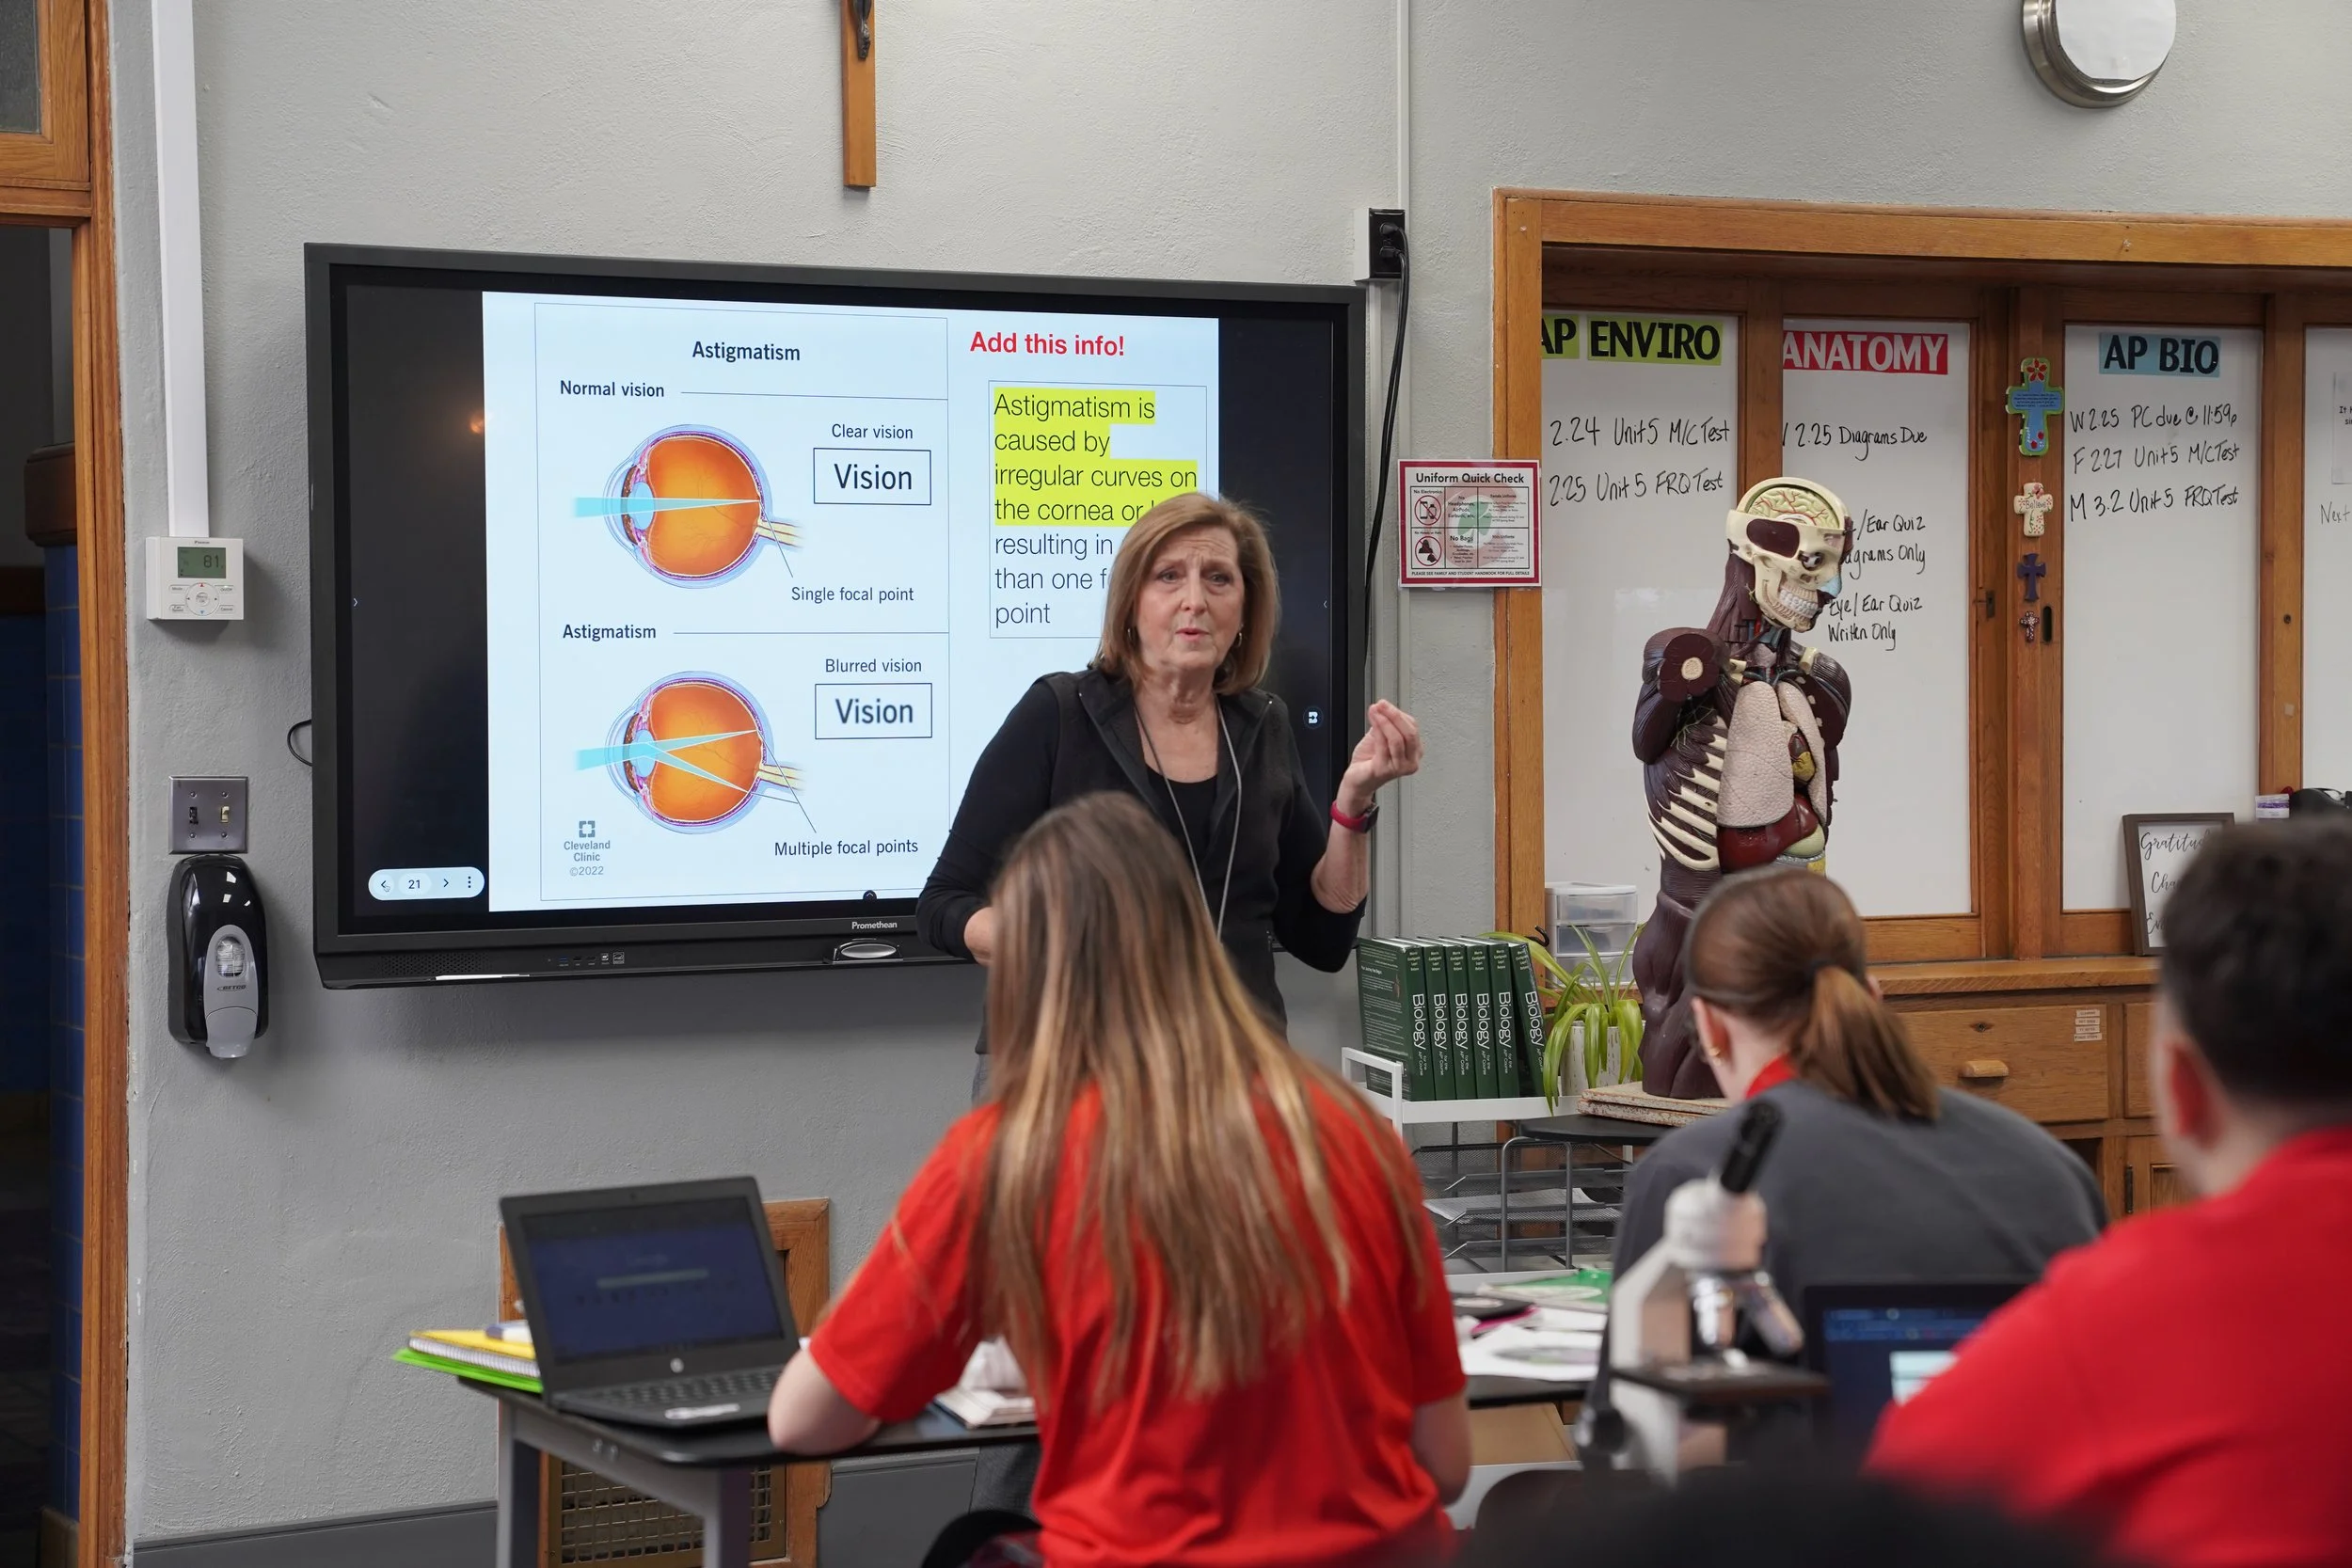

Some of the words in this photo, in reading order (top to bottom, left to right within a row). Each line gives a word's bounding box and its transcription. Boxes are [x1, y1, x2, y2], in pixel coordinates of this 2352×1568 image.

[691, 341, 802, 363] Astigmatism
[969, 330, 1018, 354] Add
[1025, 332, 1068, 355] this
[1073, 334, 1125, 356] info!
[1590, 319, 1721, 361] ENVIRO
[1783, 331, 1946, 372] ANATOMY
[2104, 334, 2148, 371] AP
[2159, 337, 2219, 374] BIO
[560, 380, 616, 397] Normal
[621, 382, 665, 398] vision
[993, 393, 1131, 422] Astigmatism
[1138, 396, 1155, 419] is
[2070, 410, 2086, 433] W
[2088, 408, 2120, 431] 2.25
[2131, 404, 2153, 428] PC
[2155, 404, 2182, 427] due
[2185, 405, 2199, 427] @
[831, 422, 870, 438] Clear
[873, 424, 914, 439] vision
[993, 430, 1076, 451] caused
[1083, 430, 1111, 457] by
[1550, 417, 1600, 446] 2.24
[1614, 417, 1645, 446] Unit
[1669, 419, 1698, 446] M/C
[1700, 417, 1730, 443] Test
[1794, 423, 1832, 447] 2.25
[1839, 425, 1898, 461] Diagrams
[1900, 425, 1928, 445] Due
[2073, 447, 2086, 474] F
[2135, 445, 2166, 468] Unit
[2188, 440, 2216, 465] M/C
[2215, 438, 2240, 462] Test
[833, 462, 914, 491] Vision
[993, 464, 1084, 491] irregular
[1090, 467, 1163, 488] curves
[1169, 468, 1198, 488] on
[1416, 472, 1459, 483] Uniform
[1461, 472, 1490, 483] Quick
[1493, 472, 1525, 483] Check
[1597, 471, 1630, 501] Unit
[1634, 472, 1647, 498] 5
[1655, 470, 1691, 495] FRQ
[1692, 467, 1724, 491] Test
[993, 499, 1030, 520] the
[1037, 501, 1114, 521] cornea
[1120, 502, 1143, 521] or
[2070, 492, 2087, 522] M
[2094, 489, 2124, 517] 3.2
[2129, 486, 2161, 515] Unit
[2184, 485, 2213, 509] FRQ
[2212, 483, 2239, 505] Test
[1893, 514, 1926, 532] Quiz
[994, 533, 1089, 561] resulting
[1095, 534, 1113, 555] in
[1899, 543, 1926, 575] Only
[203, 555, 218, 568] 81
[994, 568, 1043, 590] than
[1051, 569, 1093, 590] one
[791, 586, 835, 604] Single
[839, 586, 873, 602] focal
[878, 587, 914, 605] point
[1829, 593, 1884, 621] Eye/Ear
[1889, 595, 1923, 612] Quiz
[994, 602, 1051, 628] point
[563, 624, 658, 641] Astigmatism
[1828, 623, 1870, 643] Written
[1872, 623, 1897, 651] Only
[825, 657, 877, 673] Blurred
[882, 659, 922, 673] vision
[834, 697, 914, 725] Vision
[563, 839, 611, 851] Cleveland
[573, 850, 601, 863] Clinic
[773, 840, 833, 858] Multiple
[836, 839, 871, 856] focal
[876, 839, 918, 857] points
[409, 879, 420, 889] 21
[569, 864, 604, 877] ©2022
[851, 920, 898, 930] Promethean
[1412, 993, 1426, 1050] Biology
[1434, 993, 1447, 1050] Biology
[1454, 993, 1469, 1050] Biology
[1477, 993, 1490, 1050] Biology
[1498, 991, 1512, 1048] Biology
[1525, 990, 1545, 1046] Biology
